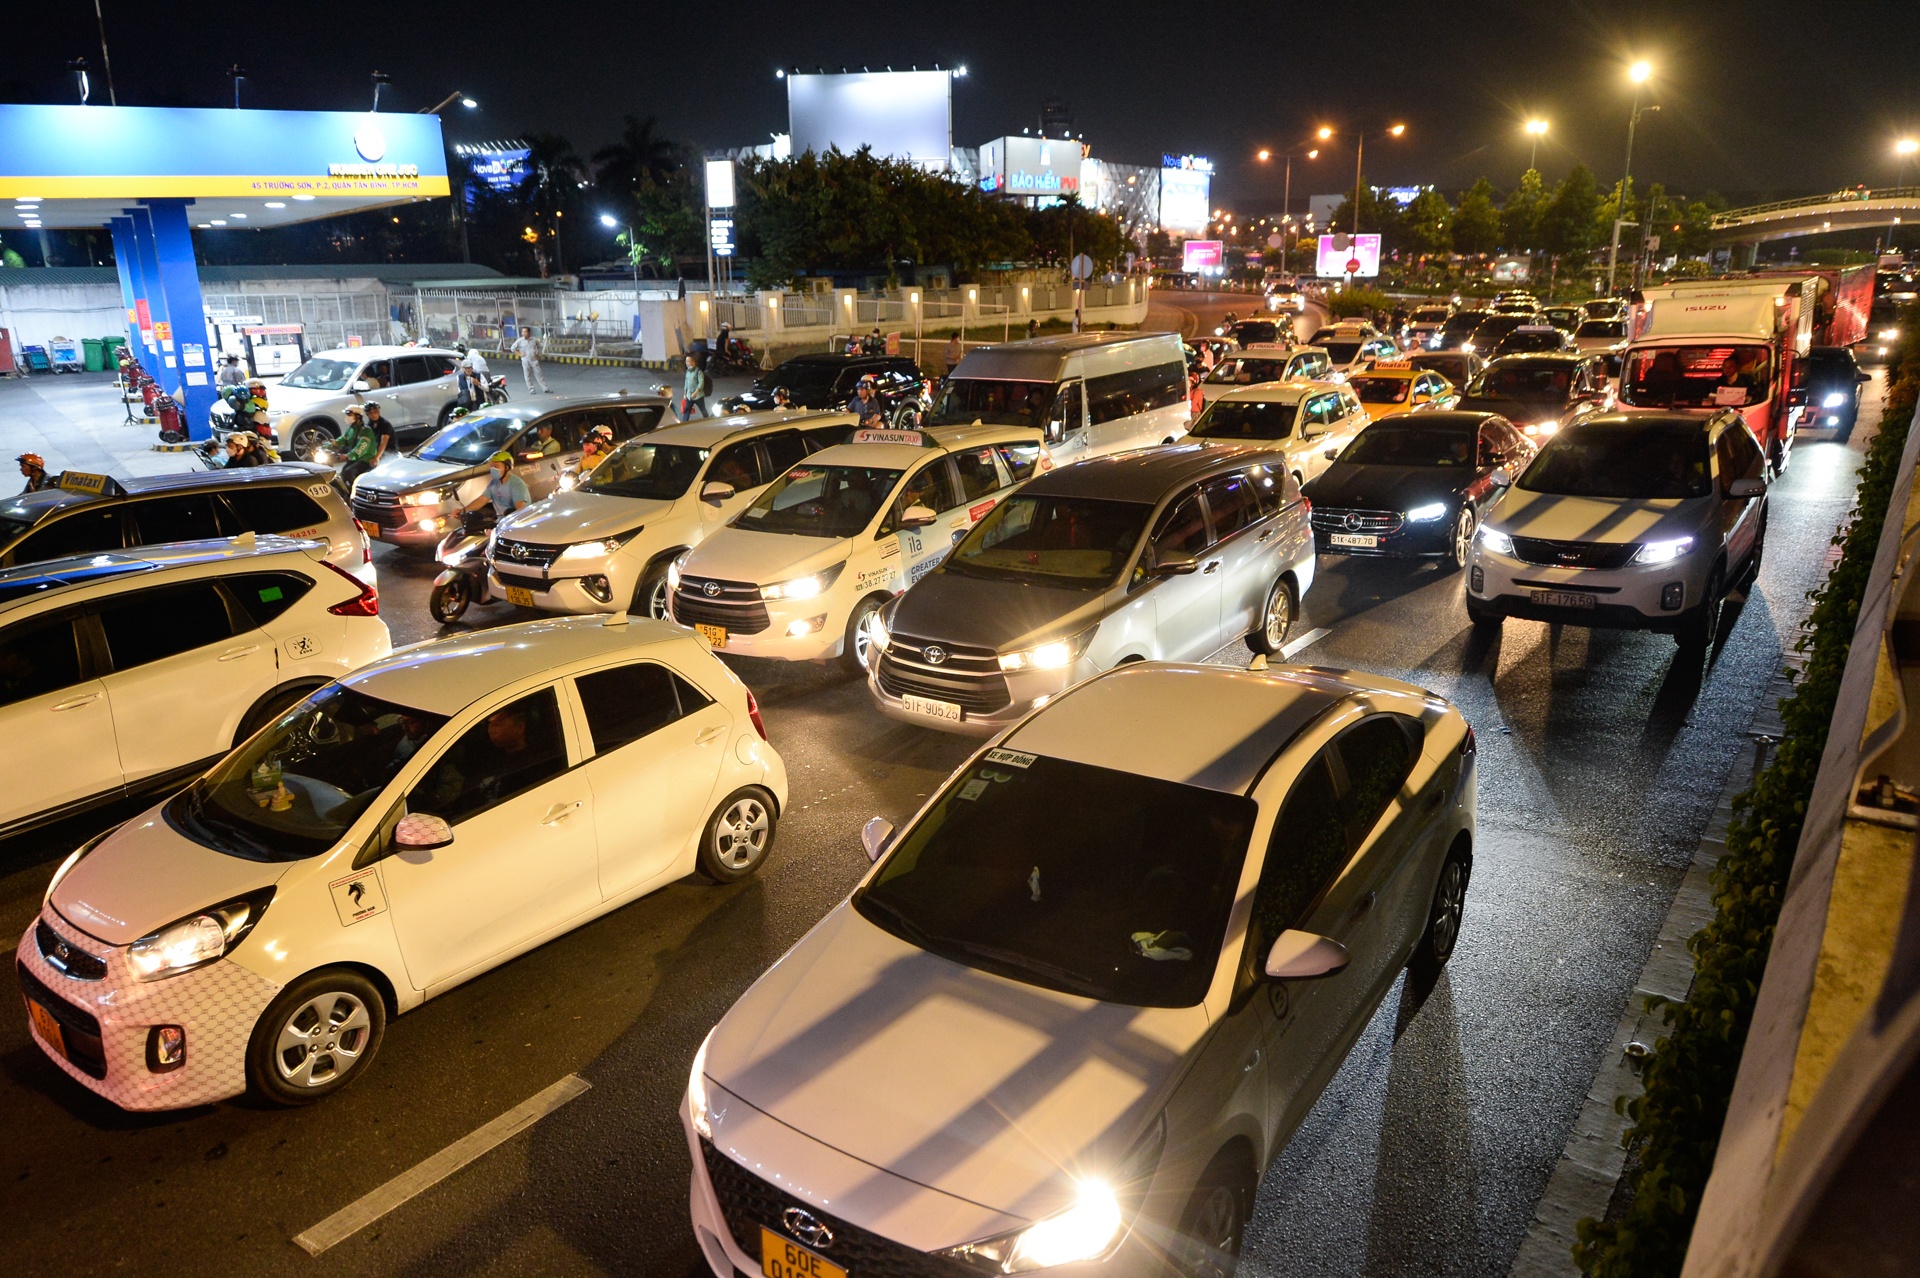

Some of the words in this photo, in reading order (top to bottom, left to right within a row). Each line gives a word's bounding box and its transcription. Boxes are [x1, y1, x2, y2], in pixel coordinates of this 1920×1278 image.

[1011, 169, 1034, 188] BẢO
[1061, 176, 1078, 190] PVI
[872, 433, 919, 443] VINASUNTAXI
[65, 472, 103, 489] Vinataxi
[309, 485, 329, 497] 1910
[908, 536, 923, 554] ila
[1332, 535, 1373, 545] 51K-487.70
[911, 557, 940, 575] GREATER
[703, 626, 717, 637] 51G
[904, 698, 958, 720] 51F-905.25
[988, 750, 999, 759] XE
[785, 1243, 822, 1278] 60E
